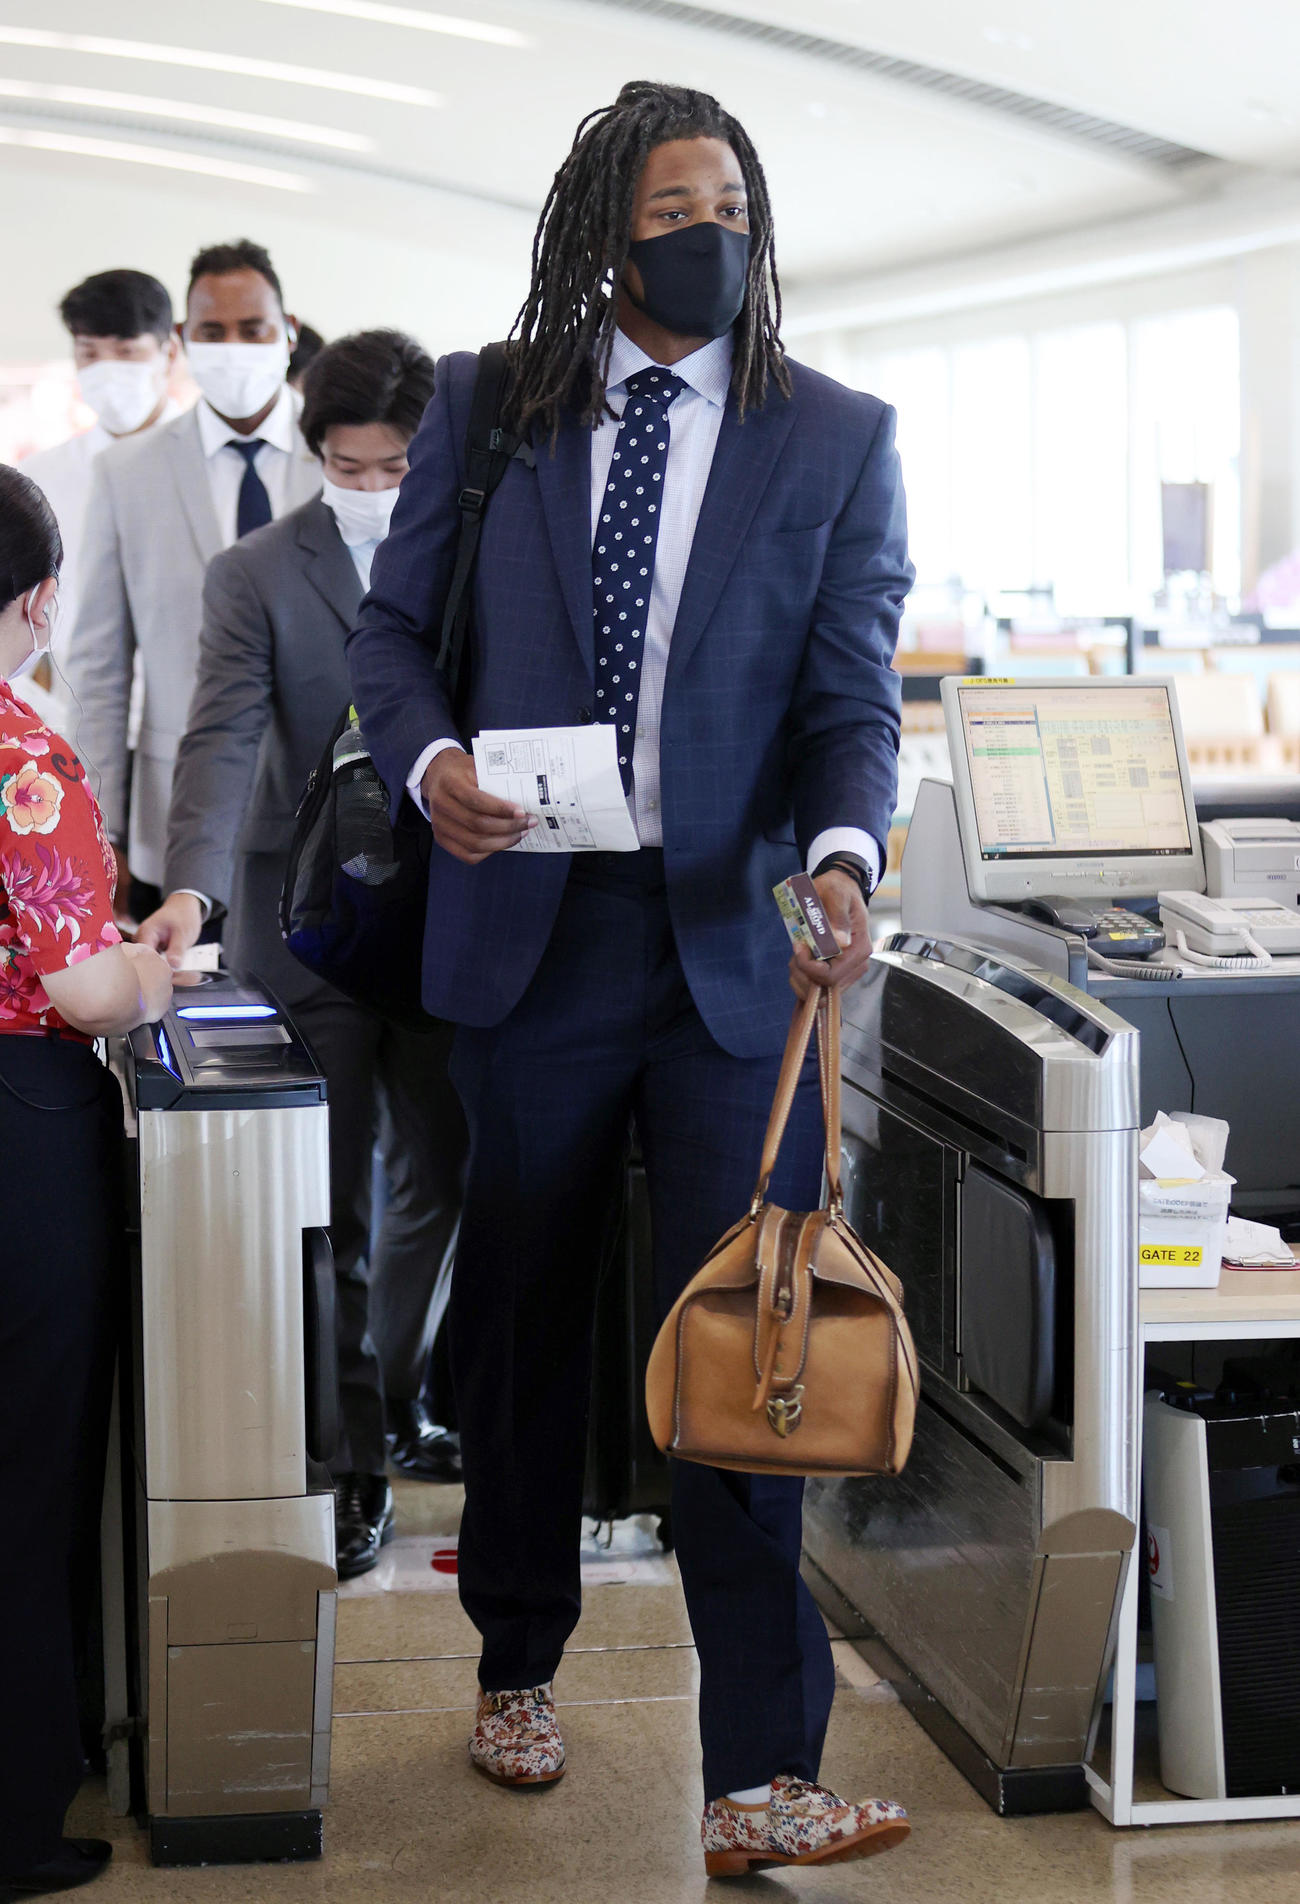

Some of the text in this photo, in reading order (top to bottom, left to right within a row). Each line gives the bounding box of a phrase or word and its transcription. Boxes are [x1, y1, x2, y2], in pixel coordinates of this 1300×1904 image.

[804, 896, 825, 935] ALMOND
[1141, 1249, 1199, 1261] GATE 22
